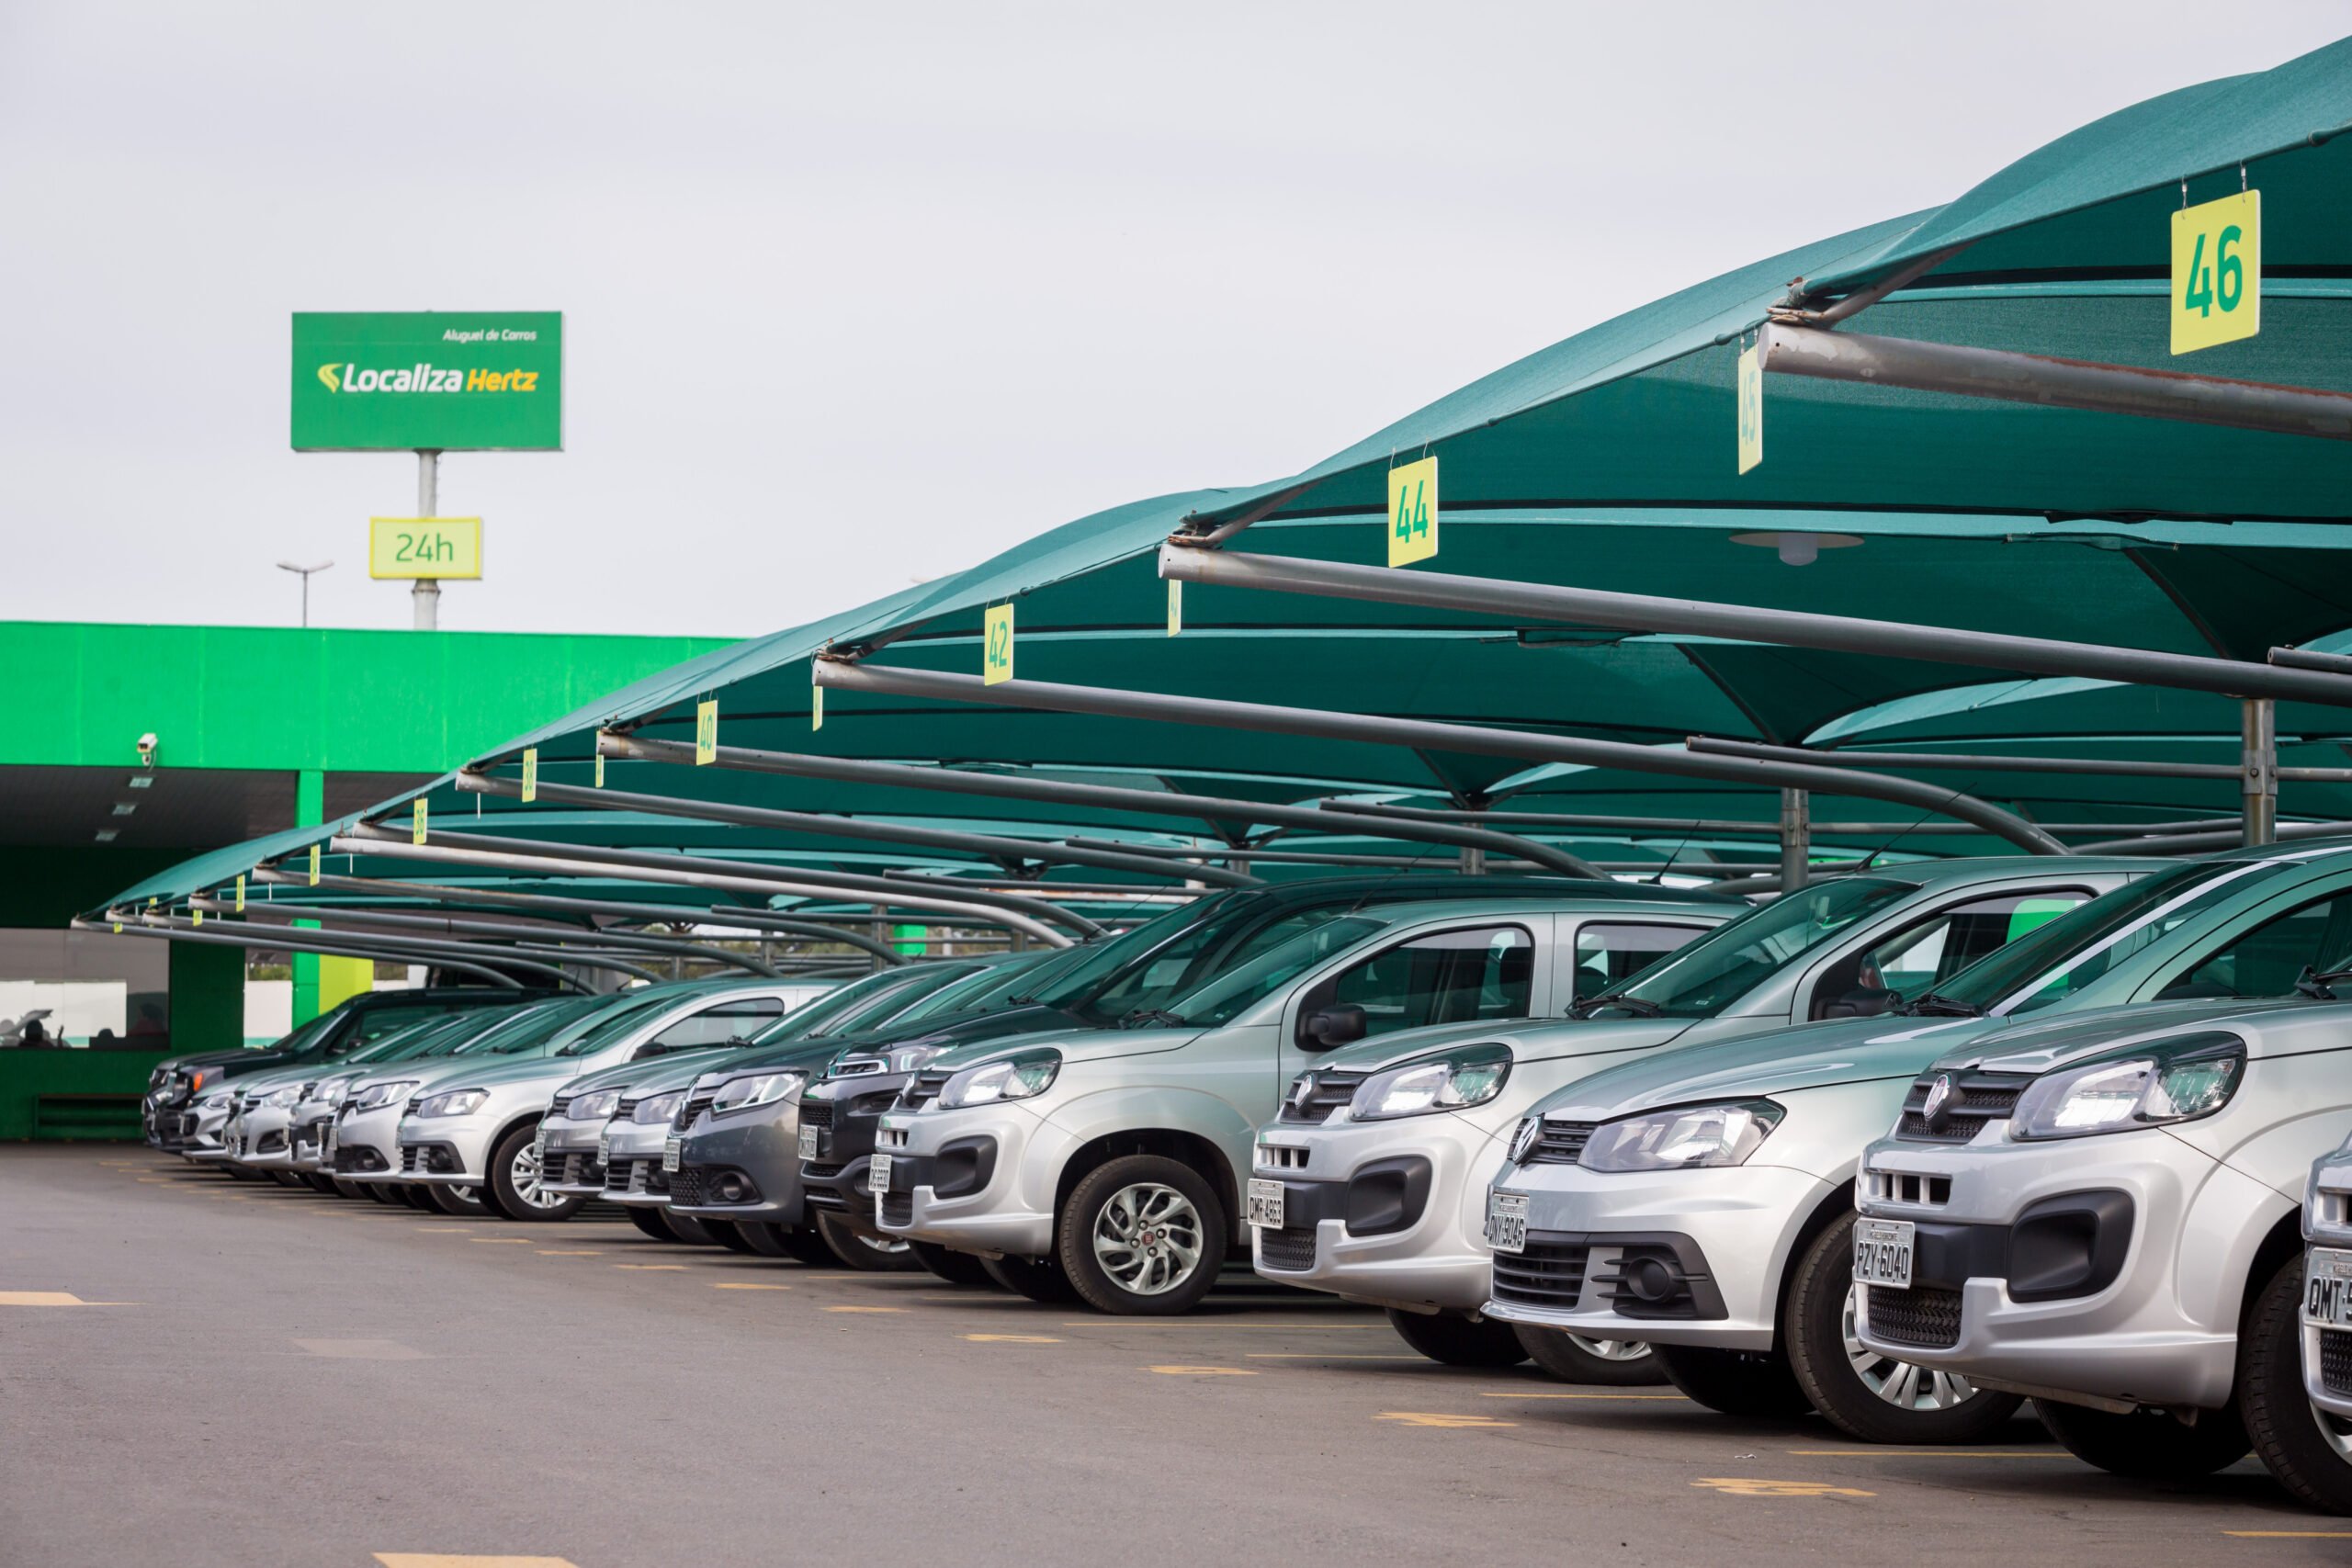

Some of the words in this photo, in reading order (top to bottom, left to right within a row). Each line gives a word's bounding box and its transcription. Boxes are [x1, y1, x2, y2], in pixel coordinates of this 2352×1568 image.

[2185, 224, 2243, 319] 46
[442, 329, 484, 344] Aluguel
[486, 329, 499, 341] de
[501, 329, 537, 341] Carros
[343, 363, 464, 392] Localiza
[466, 368, 539, 391] Hertz
[1741, 369, 1757, 446] 45
[1396, 479, 1429, 543] 44
[395, 533, 454, 562] 24h
[989, 621, 1007, 669] 42
[700, 714, 713, 752] 40
